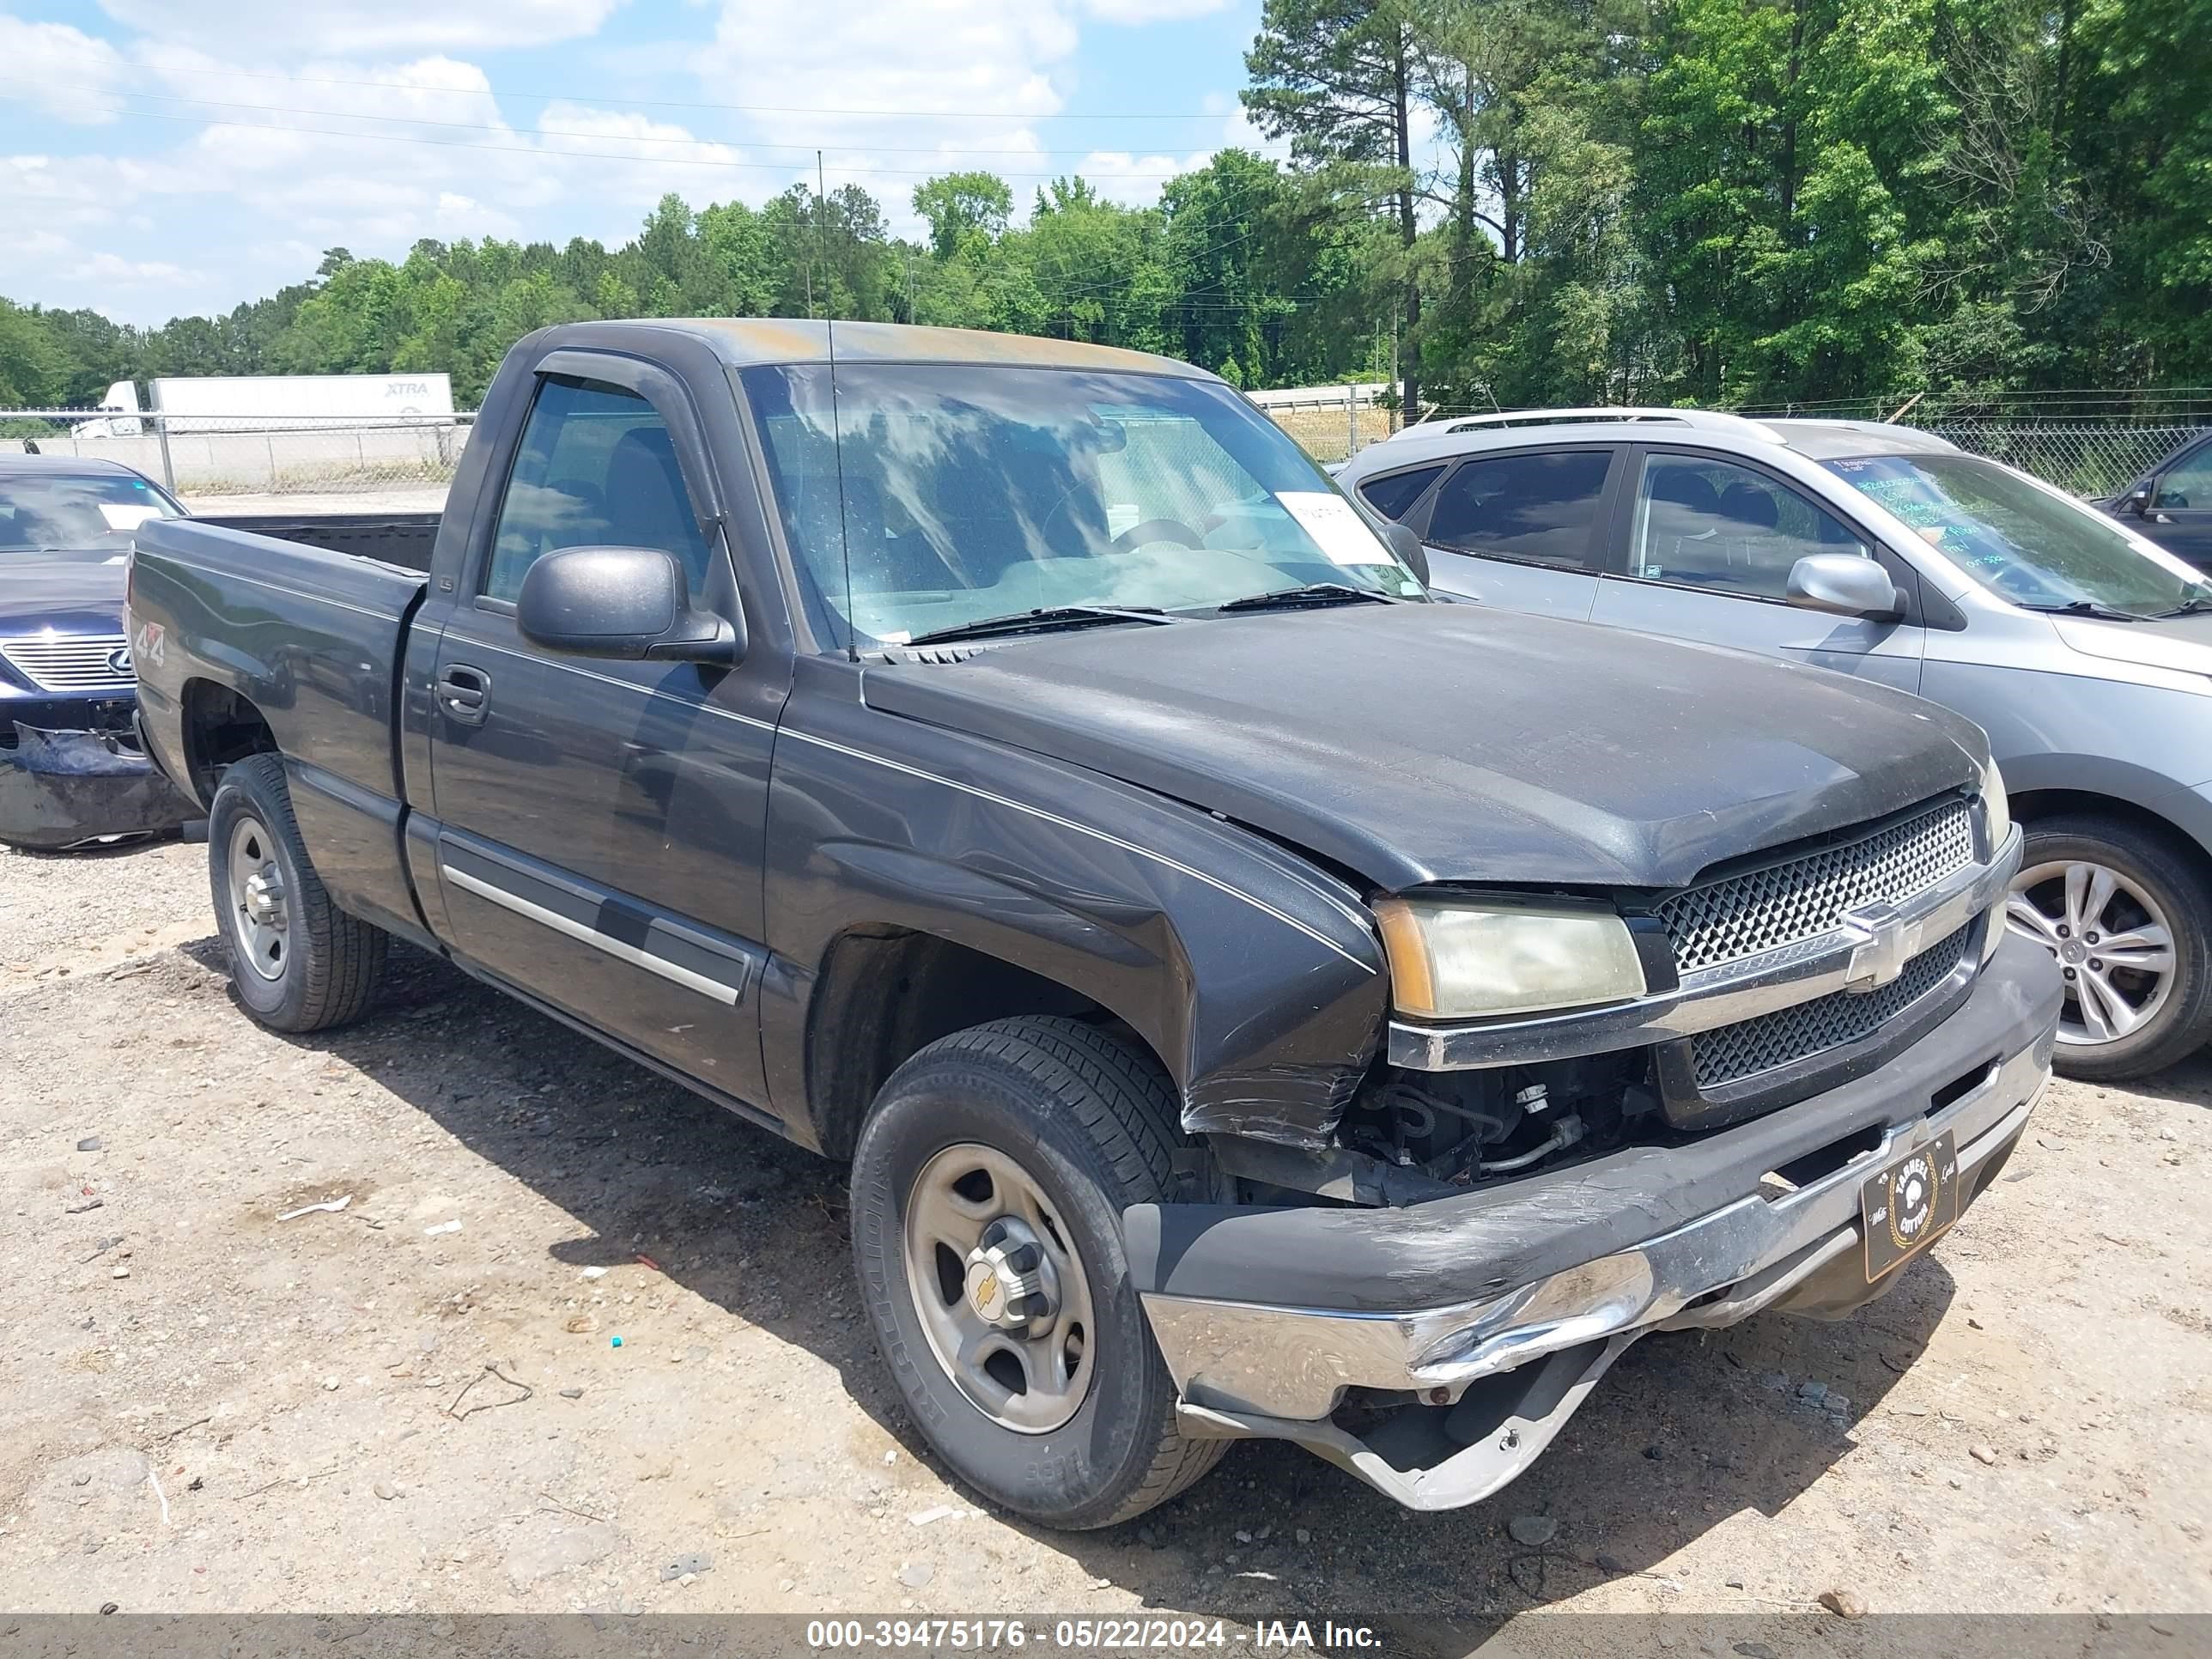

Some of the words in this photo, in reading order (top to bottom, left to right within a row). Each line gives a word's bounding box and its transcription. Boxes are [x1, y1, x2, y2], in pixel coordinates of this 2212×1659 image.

[385, 383, 428, 397] XTRA
[1895, 1158, 1929, 1194] TARHEEL
[1899, 1202, 1929, 1234] COTTON
